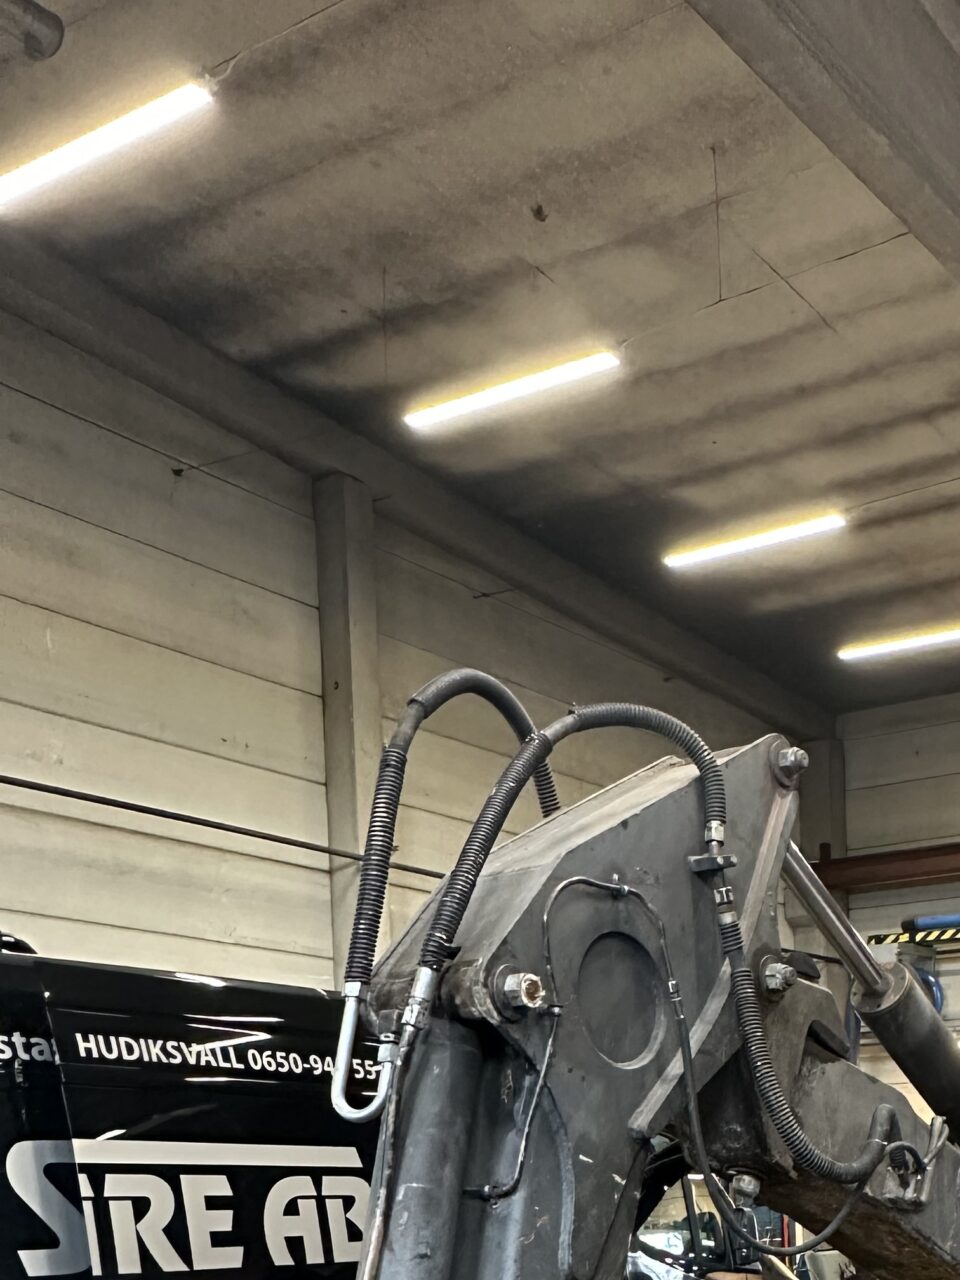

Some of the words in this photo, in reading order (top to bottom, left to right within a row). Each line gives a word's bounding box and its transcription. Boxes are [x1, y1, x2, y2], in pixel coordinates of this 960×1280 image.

[0, 1031, 58, 1063] sta
[75, 1032, 244, 1070] HUDIKSVALL
[247, 1049, 378, 1080] 0650-9455
[263, 1175, 372, 1264] AB
